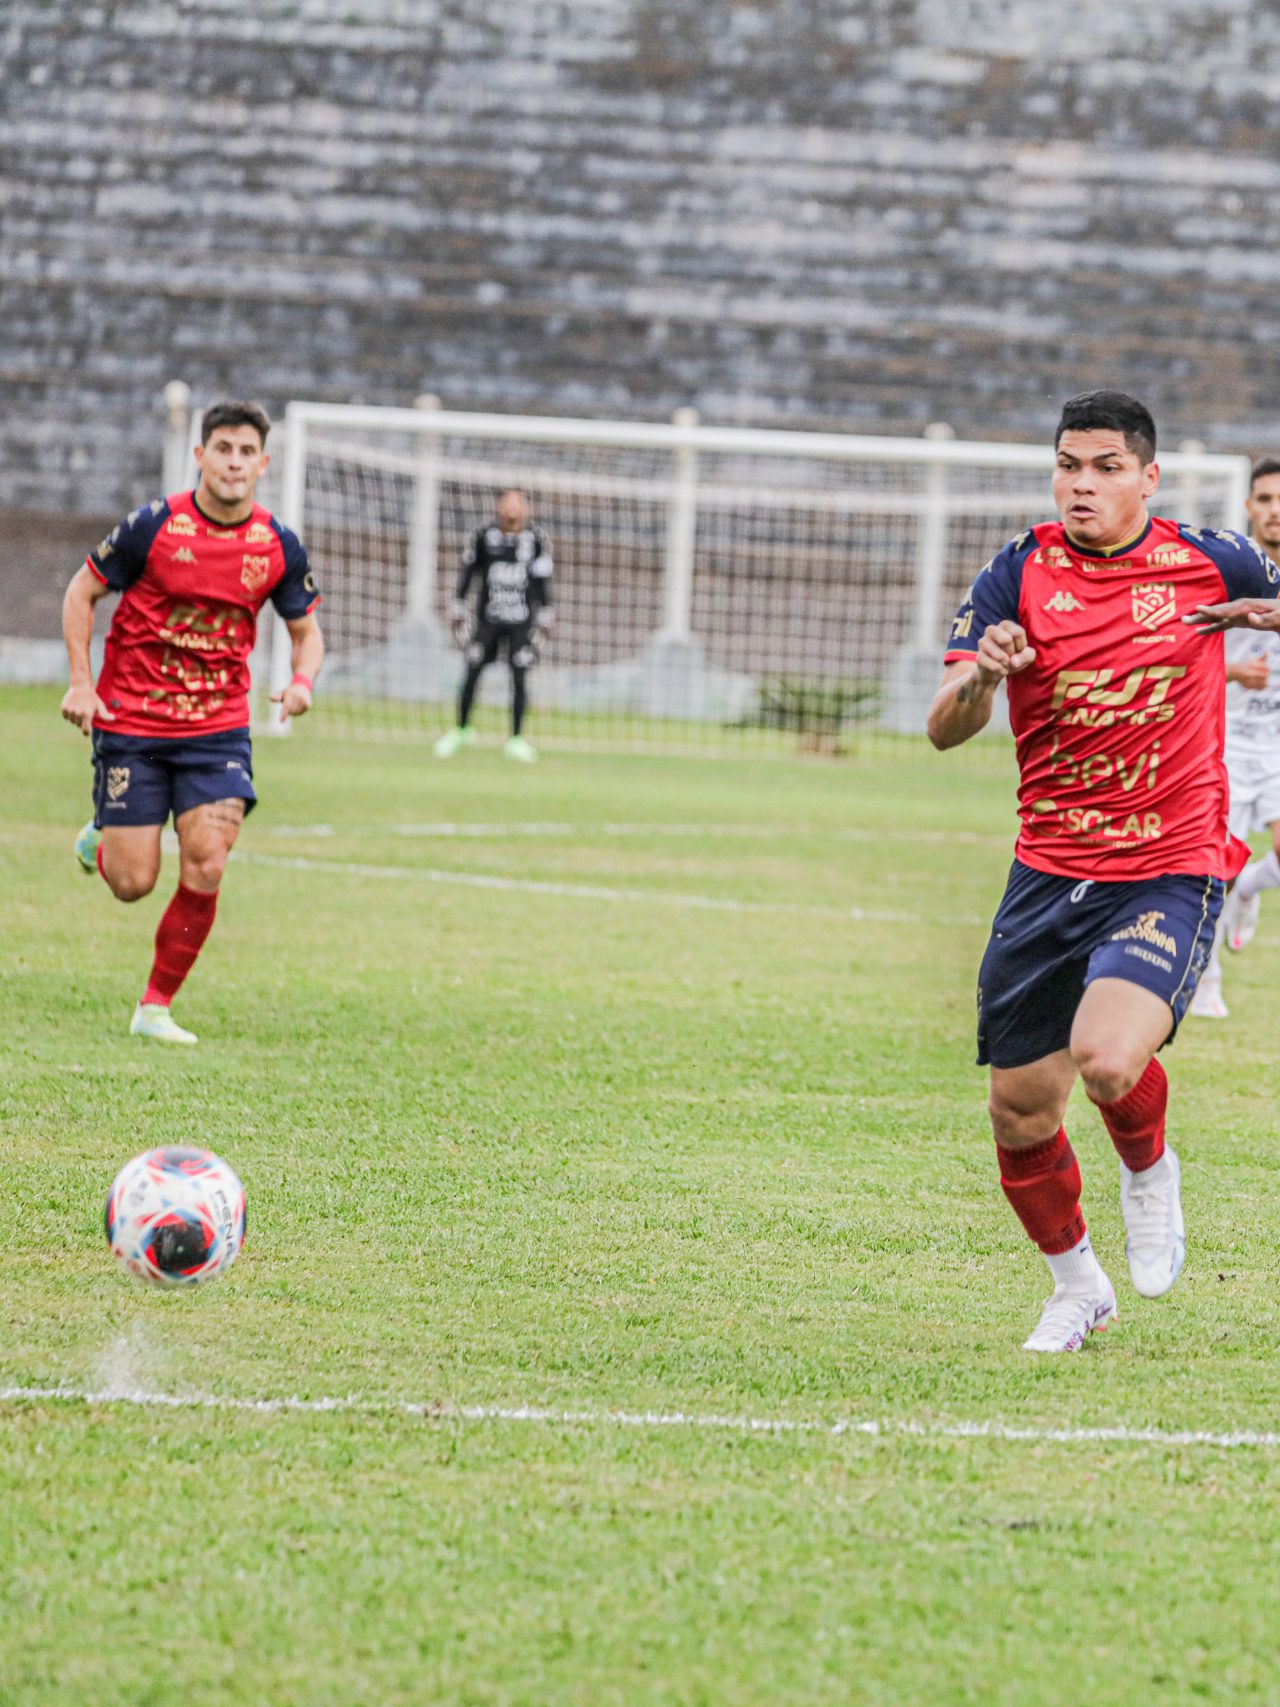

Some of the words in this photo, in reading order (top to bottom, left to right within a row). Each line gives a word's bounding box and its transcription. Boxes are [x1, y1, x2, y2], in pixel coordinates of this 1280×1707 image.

[1146, 547, 1191, 568] LIANE
[1050, 666, 1188, 710] FUT
[1052, 703, 1175, 728] ANATICS
[1049, 733, 1161, 792] bevi
[1065, 808, 1163, 838] SOLAR
